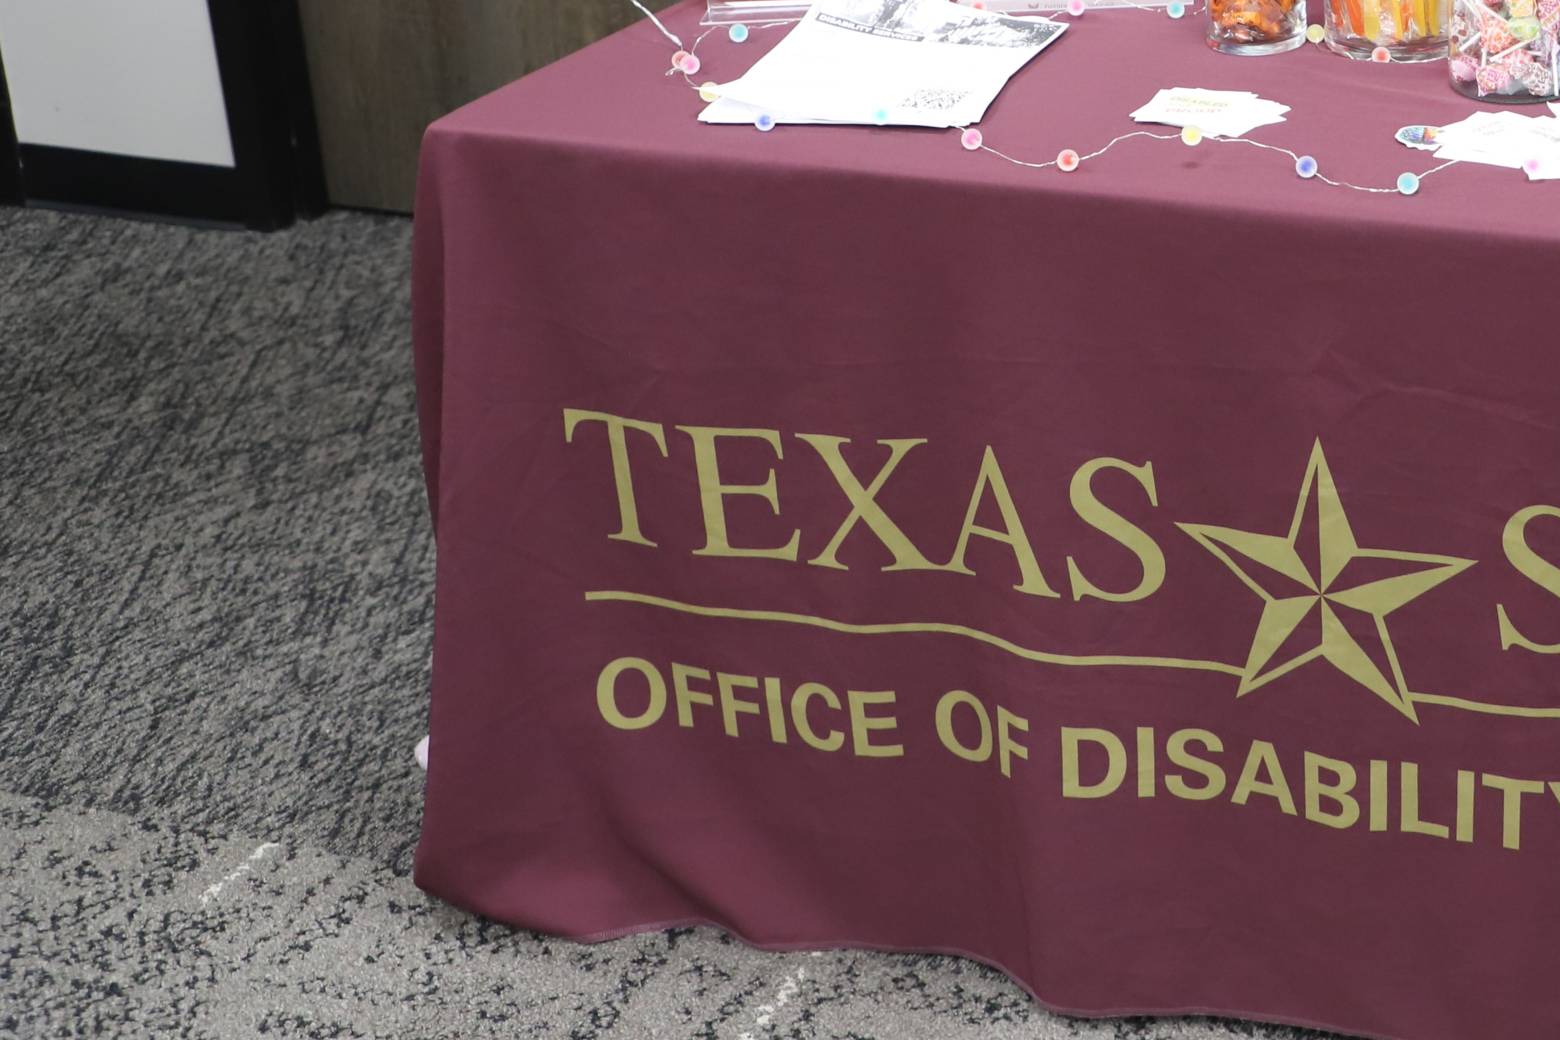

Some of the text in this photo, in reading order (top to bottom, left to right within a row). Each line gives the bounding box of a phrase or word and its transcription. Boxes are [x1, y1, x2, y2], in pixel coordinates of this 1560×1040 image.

[563, 407, 1167, 602] TEXAS
[596, 656, 904, 758] OFFICE
[935, 690, 1029, 779] OF
